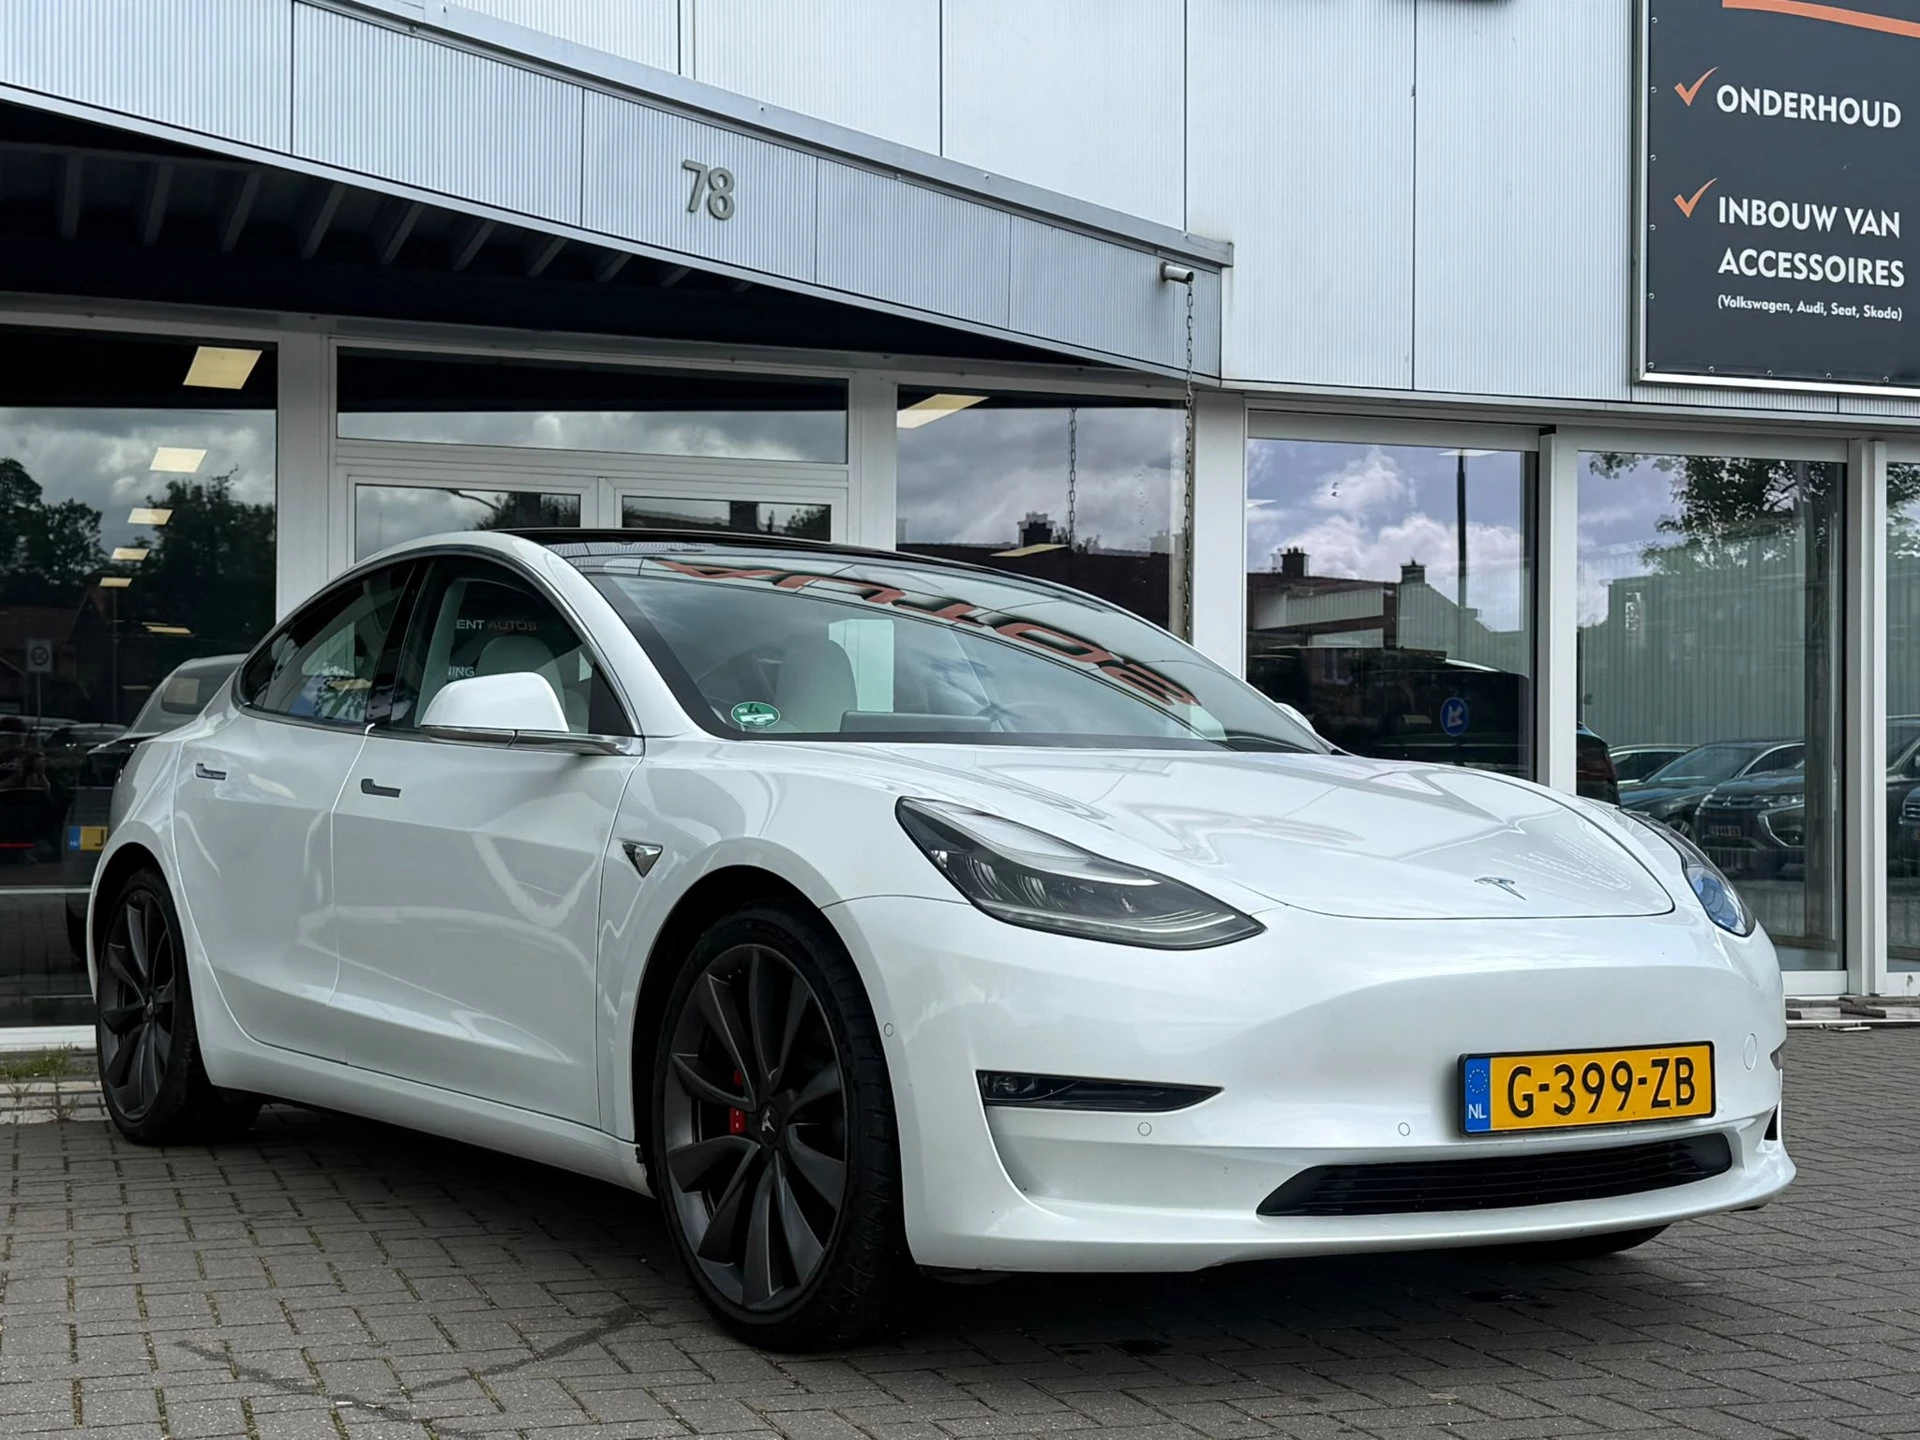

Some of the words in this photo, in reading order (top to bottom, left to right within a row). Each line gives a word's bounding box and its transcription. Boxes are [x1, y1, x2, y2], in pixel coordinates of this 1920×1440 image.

[1716, 84, 1902, 128] ONDERHOUD
[681, 159, 736, 221] 78
[1718, 196, 1838, 232] INBOUW
[1844, 206, 1900, 239] VAN
[1717, 247, 1905, 288] ACCESSOIRES
[1717, 294, 1793, 314] (Volkswagen,
[1796, 300, 1828, 316] Audi,
[1831, 302, 1860, 318] Seat,
[1863, 304, 1902, 322] Skoda)
[456, 619, 485, 631] ENT
[487, 619, 538, 632] AUTOS
[1468, 1103, 1487, 1119] NL
[1507, 1056, 1696, 1118] G-399-ZB
